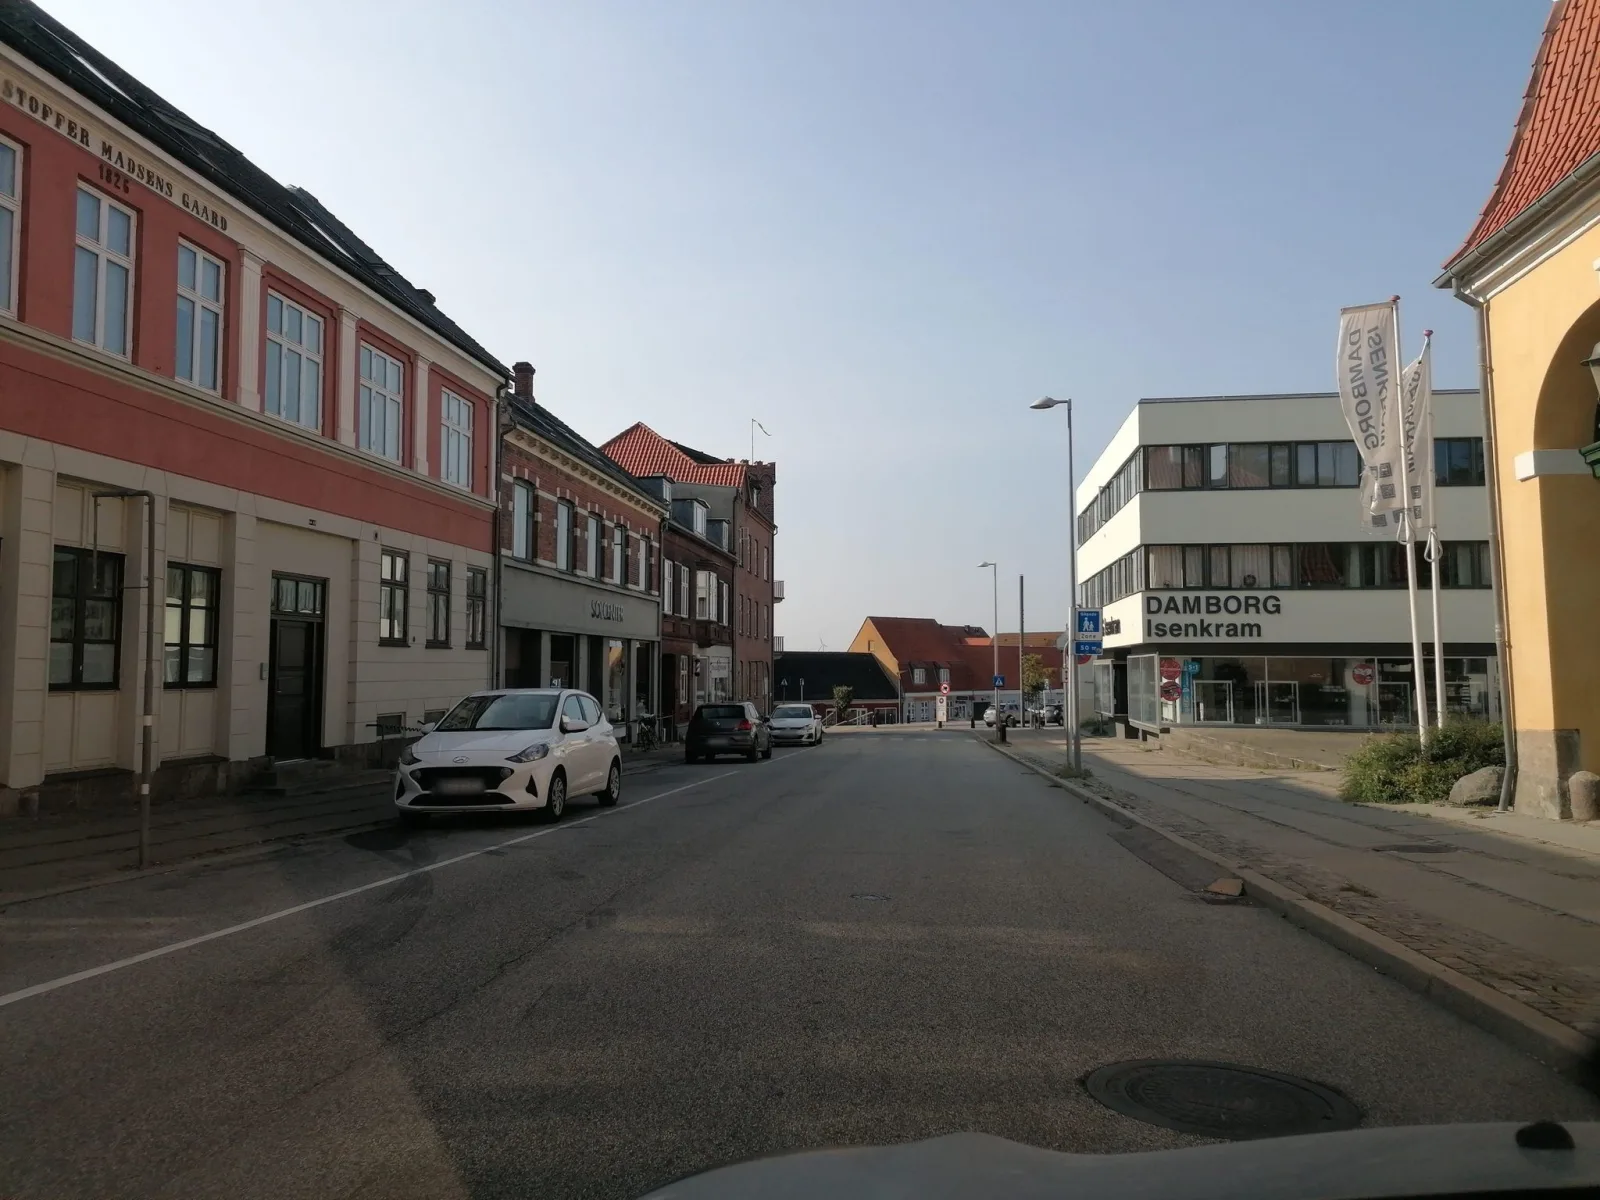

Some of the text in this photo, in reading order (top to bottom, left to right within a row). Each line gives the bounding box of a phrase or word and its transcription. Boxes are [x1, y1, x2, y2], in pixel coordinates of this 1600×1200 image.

[2, 79, 228, 231] STOFFER MADSENS GAARD
[1146, 595, 1281, 614] DAMBORG
[1147, 619, 1262, 637] Isenkram
